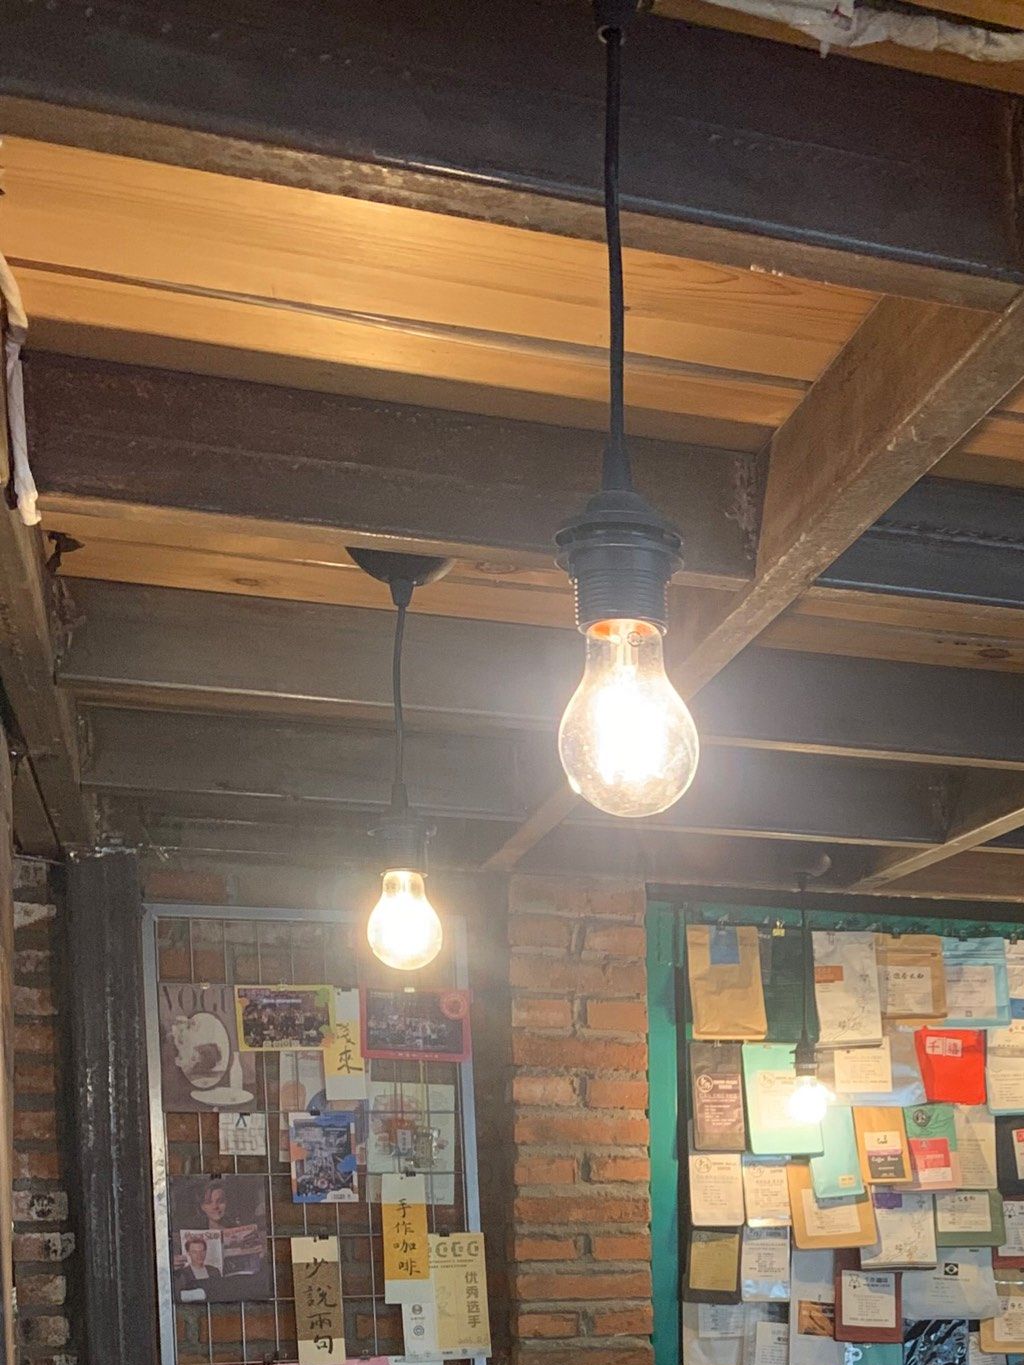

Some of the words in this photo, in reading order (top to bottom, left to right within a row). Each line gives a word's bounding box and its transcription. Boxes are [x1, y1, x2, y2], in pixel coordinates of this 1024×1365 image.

[162, 985, 236, 1012] VOGU
[393, 1198, 420, 1276] 手作咖啡
[465, 1271, 481, 1329] 优秀选手
